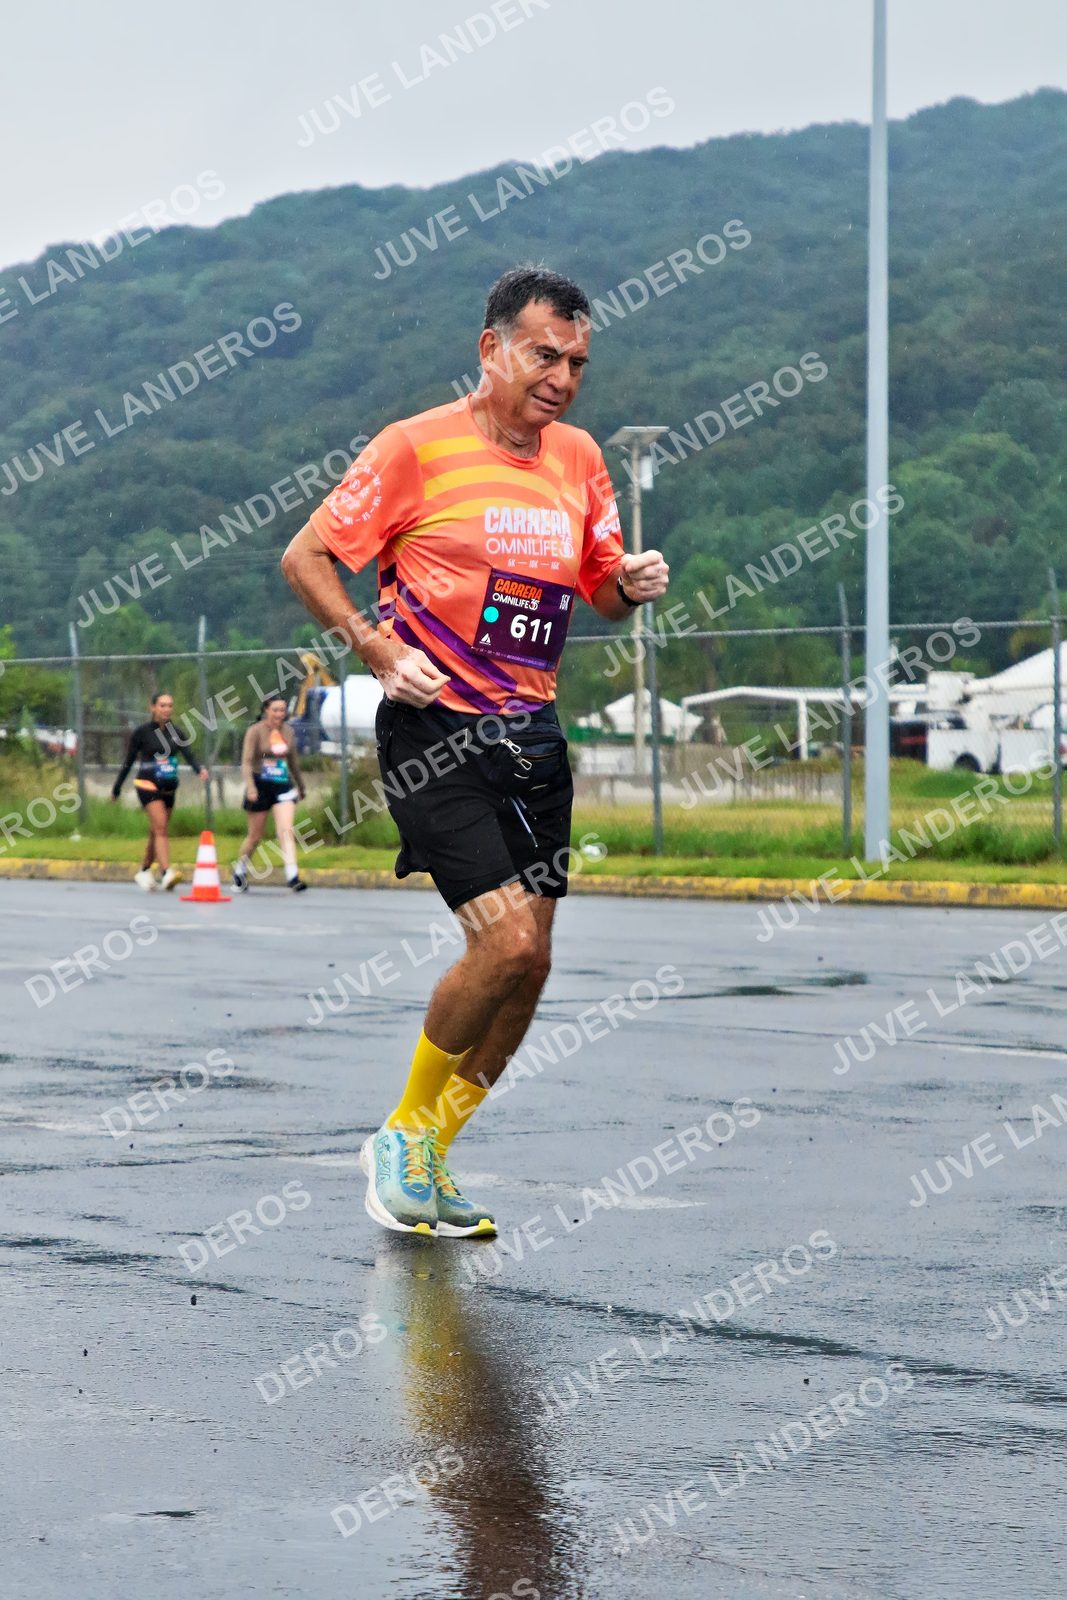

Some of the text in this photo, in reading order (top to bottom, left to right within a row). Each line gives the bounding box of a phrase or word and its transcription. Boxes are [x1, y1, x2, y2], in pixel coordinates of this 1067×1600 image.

[484, 506, 572, 537] CARRERA
[486, 537, 559, 558] OMNILIFE
[492, 592, 529, 609] OMNILIFE
[494, 578, 543, 601] CARRERA
[510, 613, 552, 645] 611
